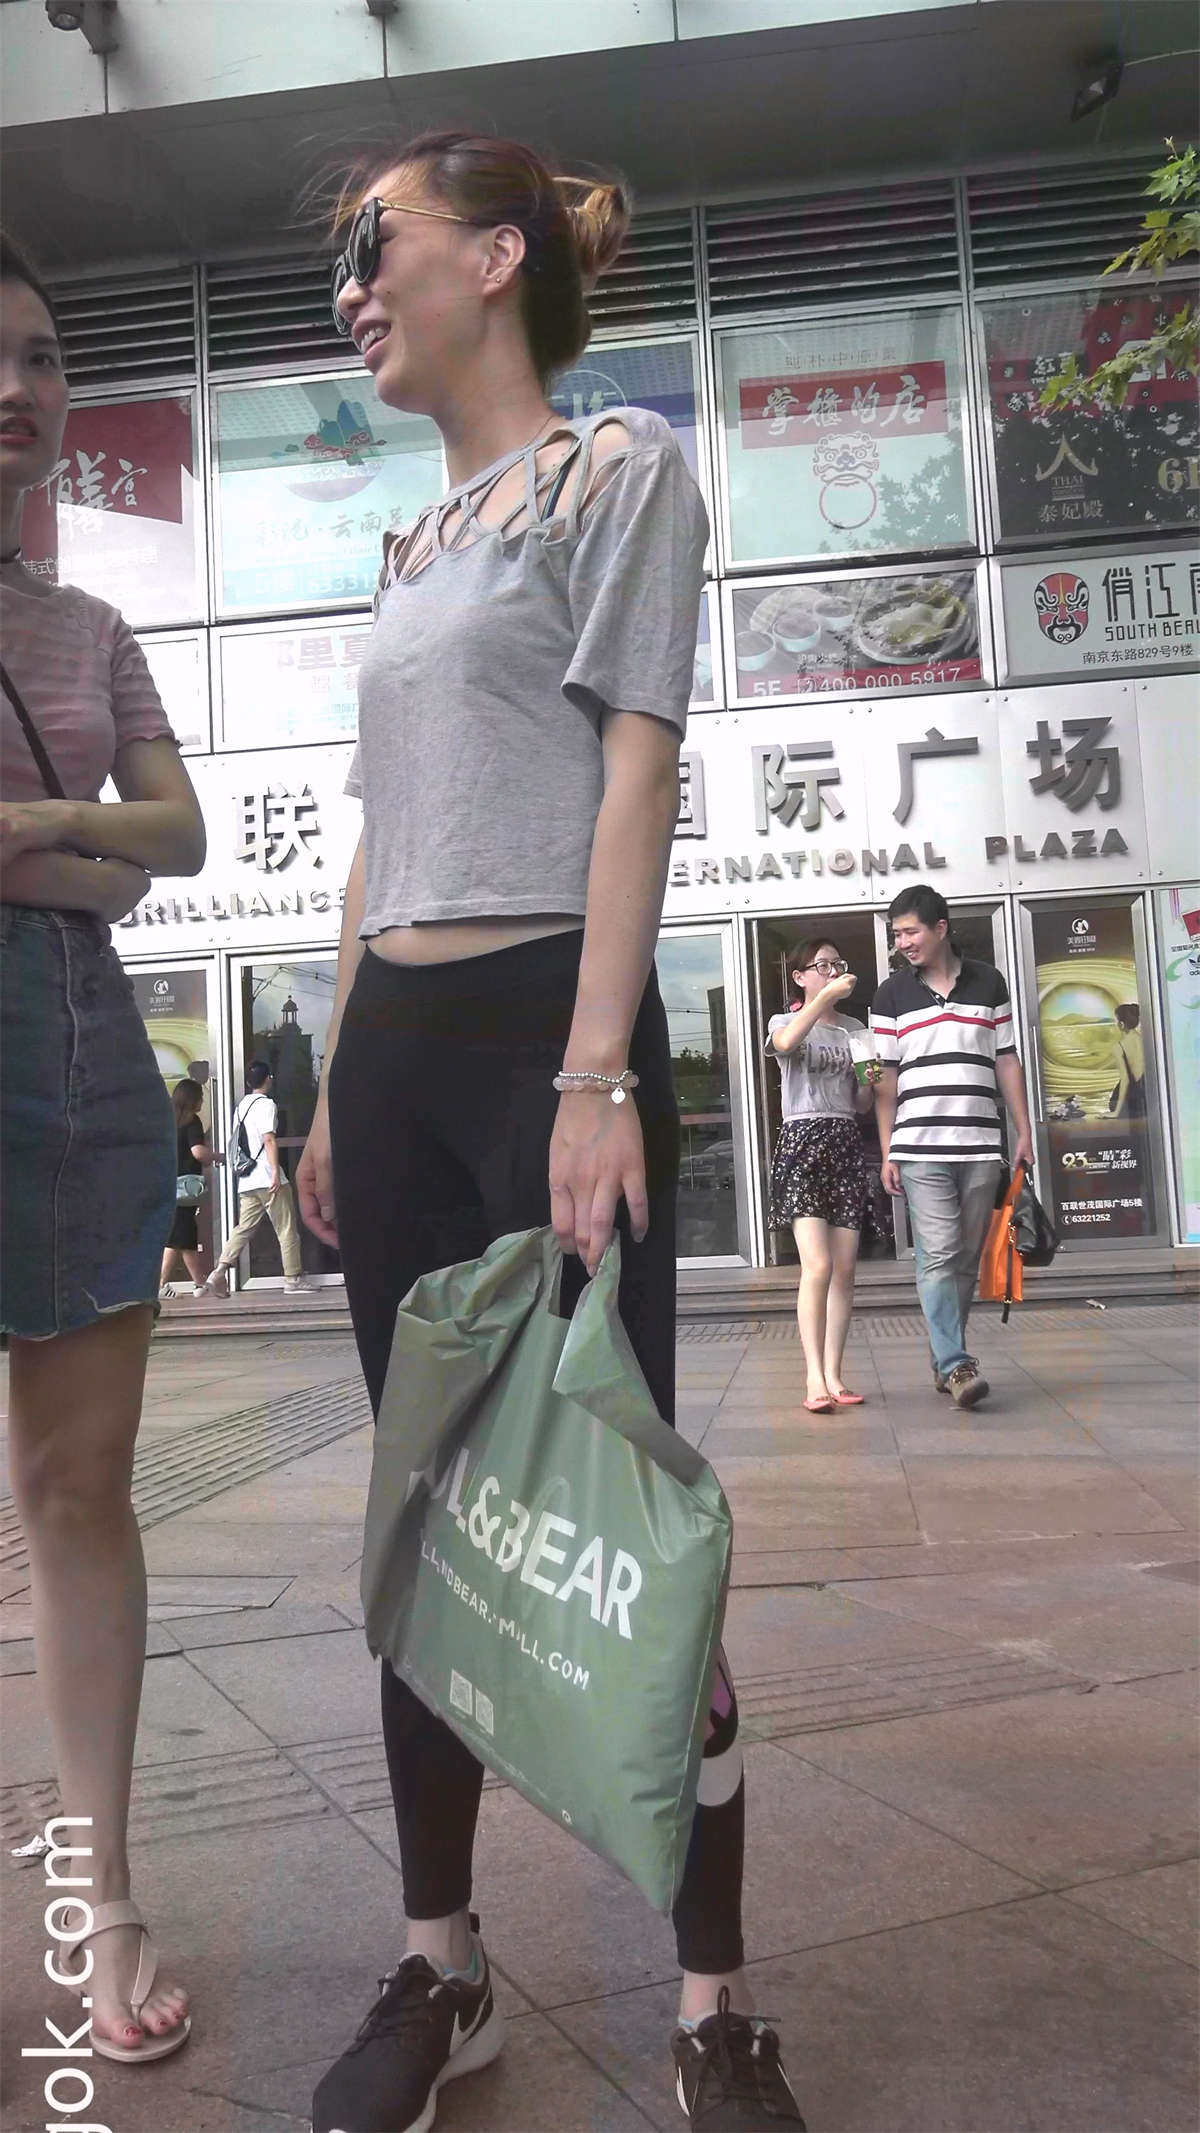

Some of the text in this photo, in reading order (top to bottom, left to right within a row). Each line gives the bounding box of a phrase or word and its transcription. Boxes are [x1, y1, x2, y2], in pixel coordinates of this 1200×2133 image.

[1052, 475, 1084, 487] THAI
[1039, 499, 1104, 523] 泰妃殿
[1105, 623, 1158, 642] SOUTH
[1081, 642, 1194, 665] 南京东路829号9楼
[819, 676, 857, 693] 400
[864, 673, 903, 688] 000
[910, 666, 961, 684] 5917
[984, 827, 1130, 864] PLAZA
[1072, 1213, 1111, 1223] 63221252
